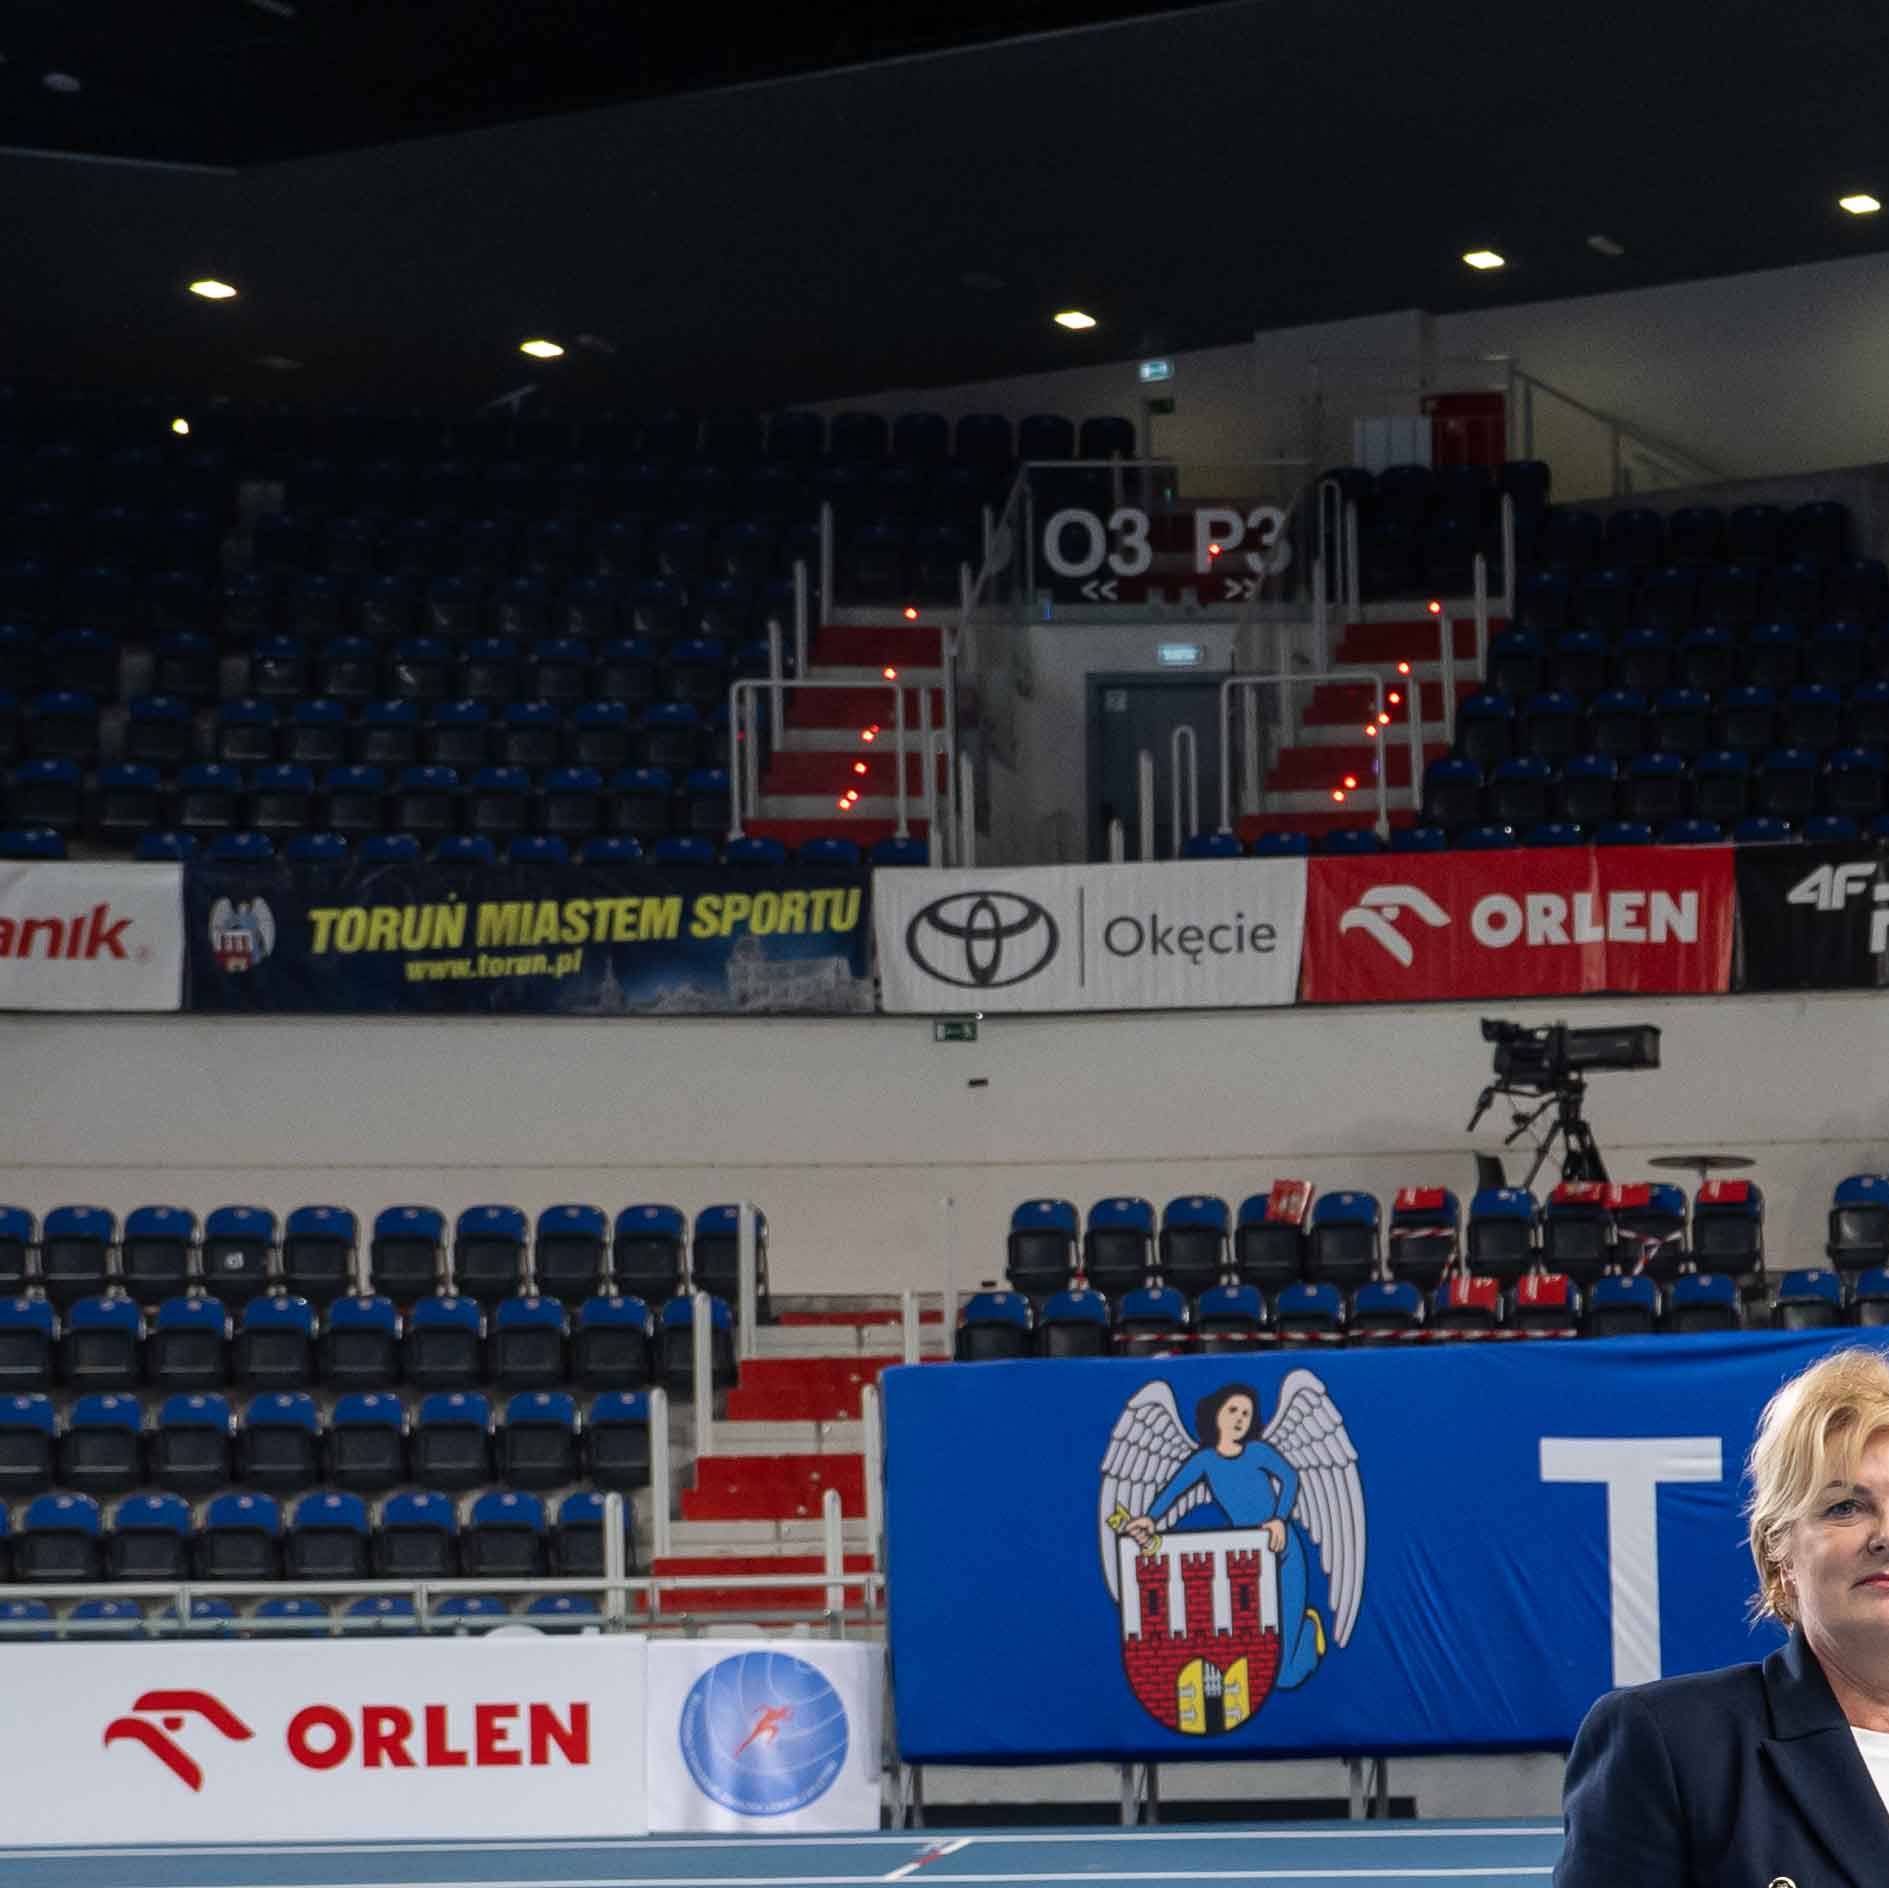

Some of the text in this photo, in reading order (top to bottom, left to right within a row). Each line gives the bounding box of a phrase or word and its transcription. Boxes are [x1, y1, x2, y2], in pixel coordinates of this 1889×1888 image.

[1043, 506, 1292, 577] O3 P3
[308, 889, 861, 954] TORUŃ MIASTEM SPORTU
[1103, 912, 1278, 966] Okęcie
[1471, 890, 1698, 948] ORLEN
[287, 1702, 589, 1769] ORLEN
